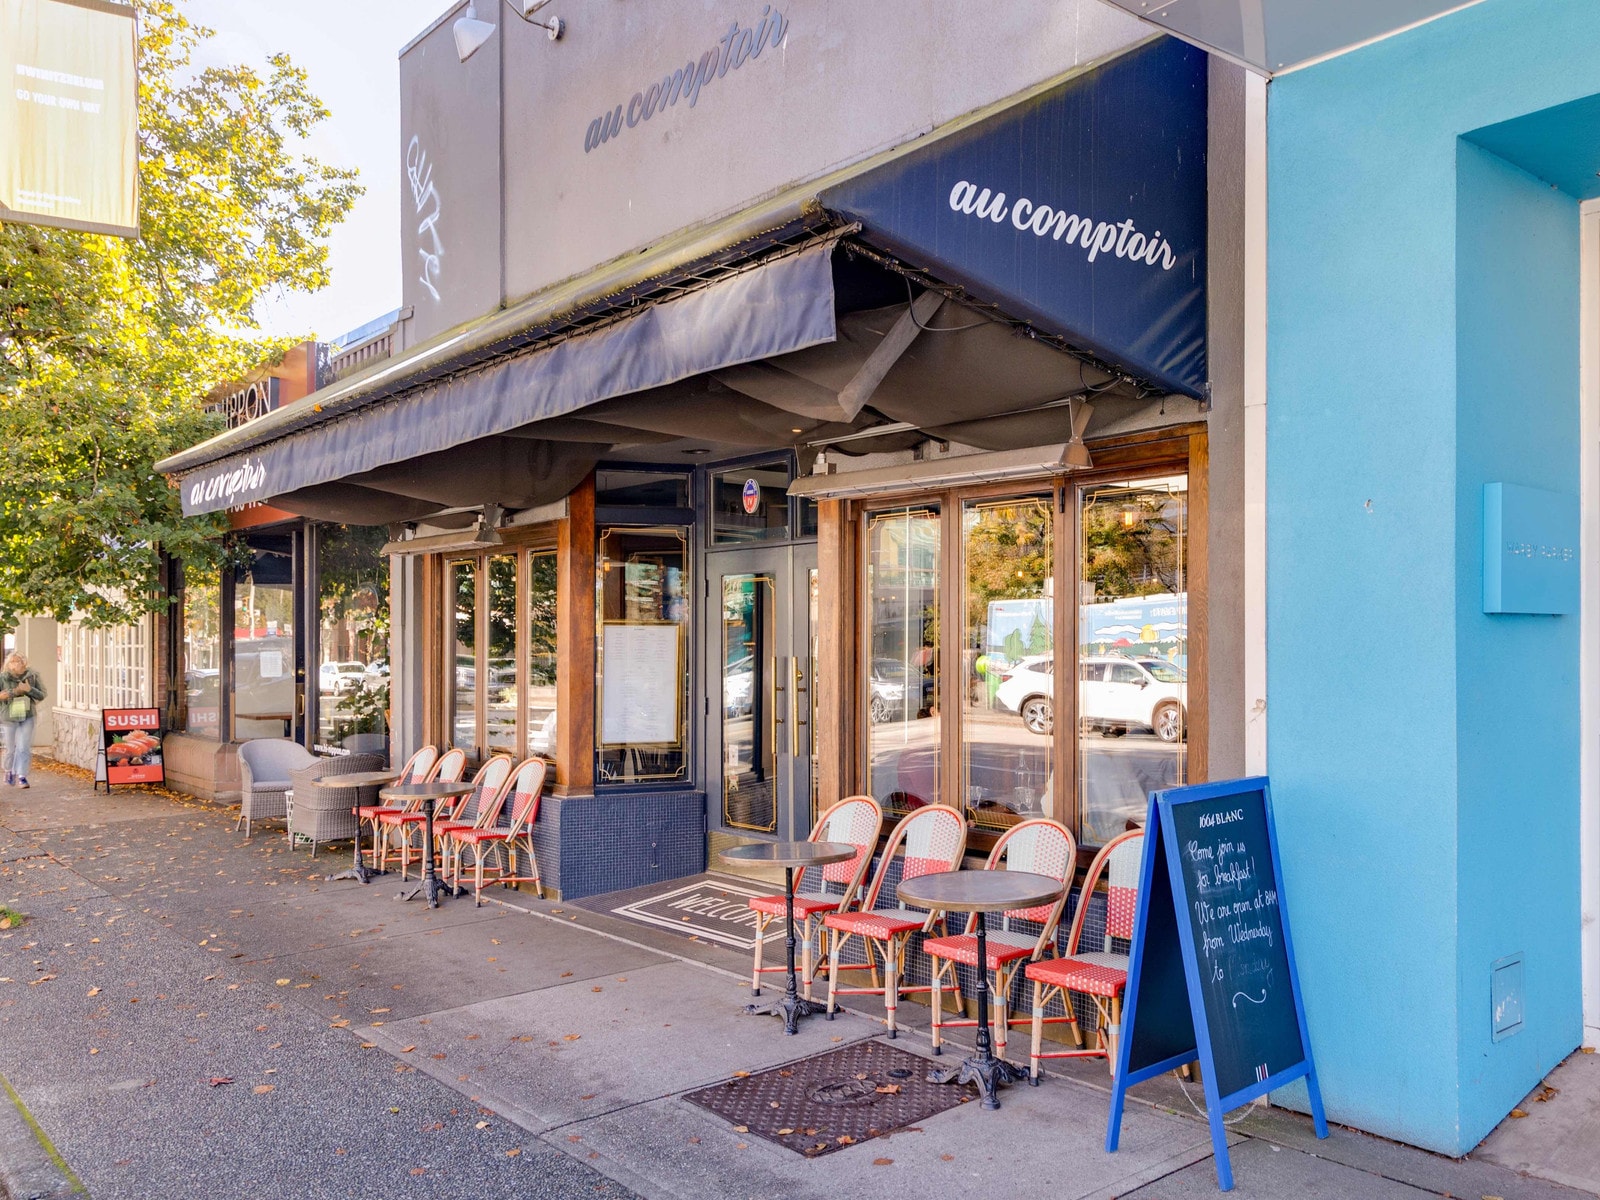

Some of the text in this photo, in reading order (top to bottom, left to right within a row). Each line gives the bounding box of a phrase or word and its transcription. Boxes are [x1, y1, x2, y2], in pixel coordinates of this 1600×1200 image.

[584, 4, 789, 154] au comptoir
[949, 180, 1177, 271] au comptoir
[107, 714, 156, 727] SUSHI
[1199, 808, 1244, 828] 1664 BLANC
[1188, 838, 1246, 866] Come join us
[1195, 901, 1215, 925] We
[1217, 906, 1231, 919] are
[1233, 900, 1252, 923] open
[1253, 889, 1264, 909] at
[1203, 920, 1273, 958] from Wednesday
[1212, 960, 1224, 983] to
